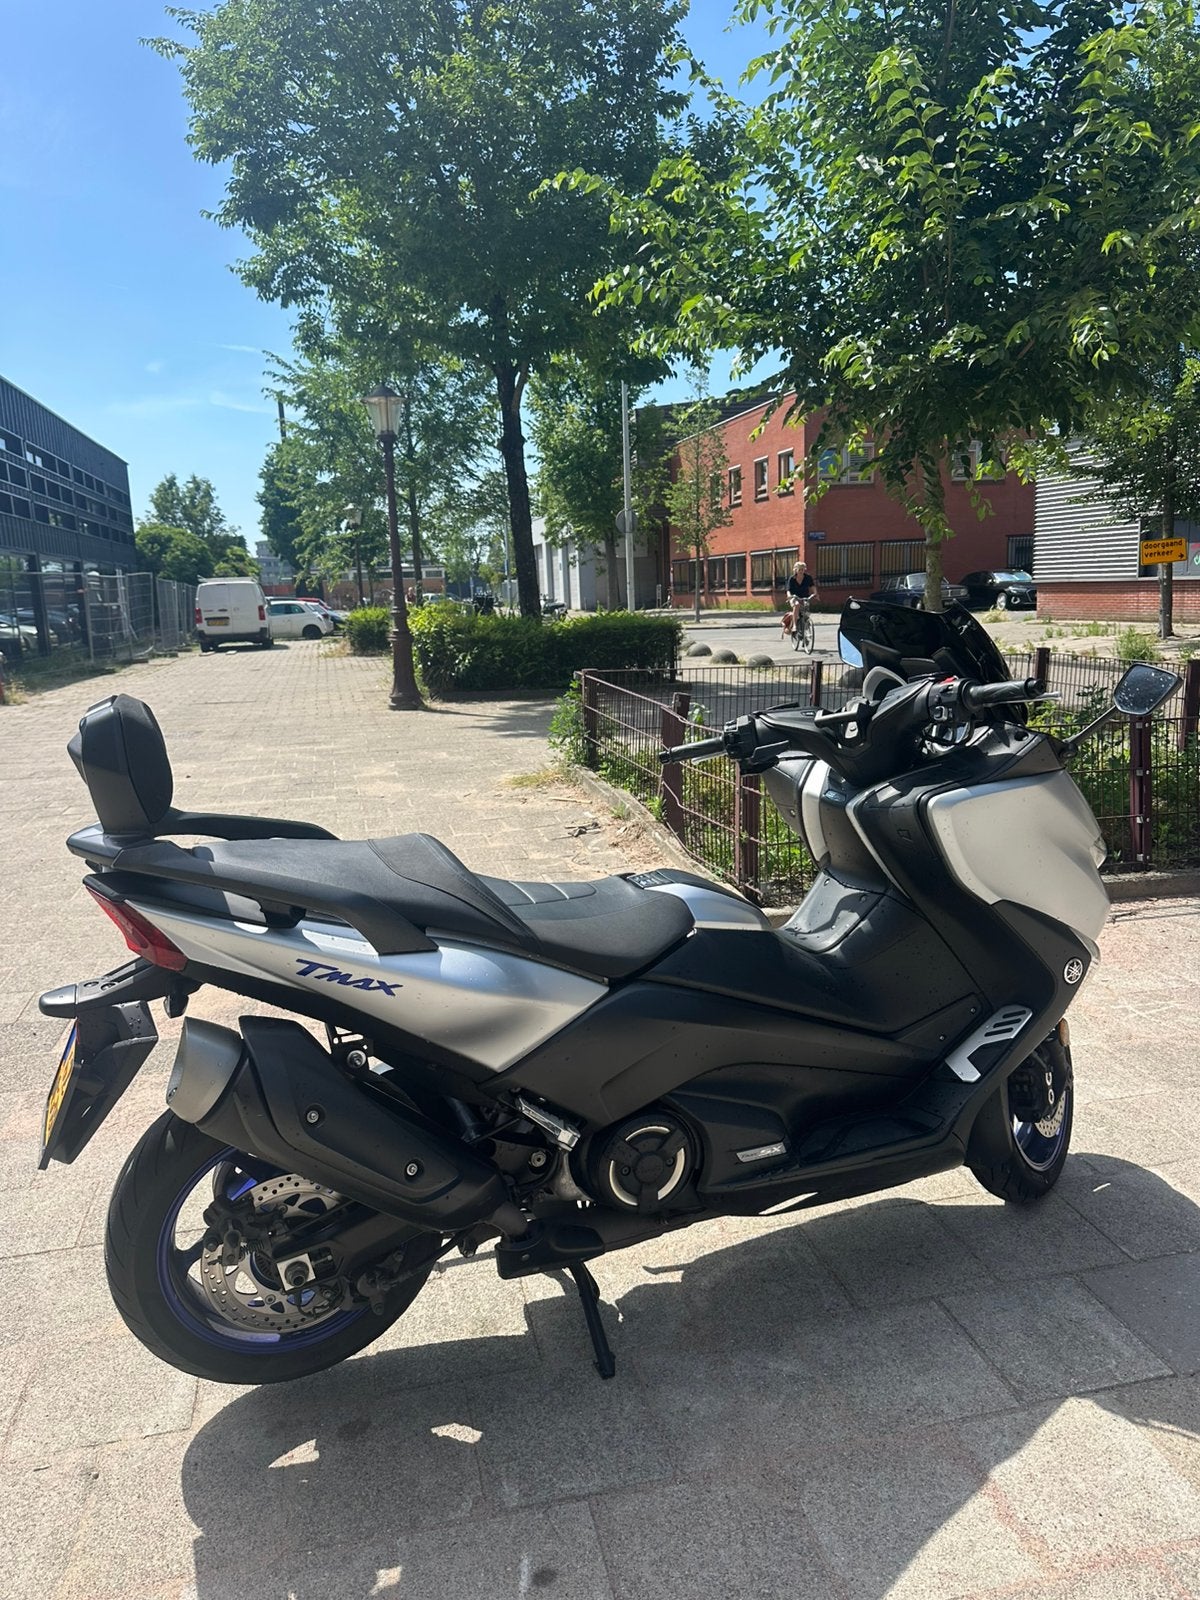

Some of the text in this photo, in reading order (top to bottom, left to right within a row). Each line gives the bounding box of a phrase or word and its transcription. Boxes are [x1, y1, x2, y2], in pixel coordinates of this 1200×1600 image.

[1144, 540, 1183, 550] doorgaand
[1144, 550, 1174, 558] verkeer
[295, 958, 404, 997] TMAX
